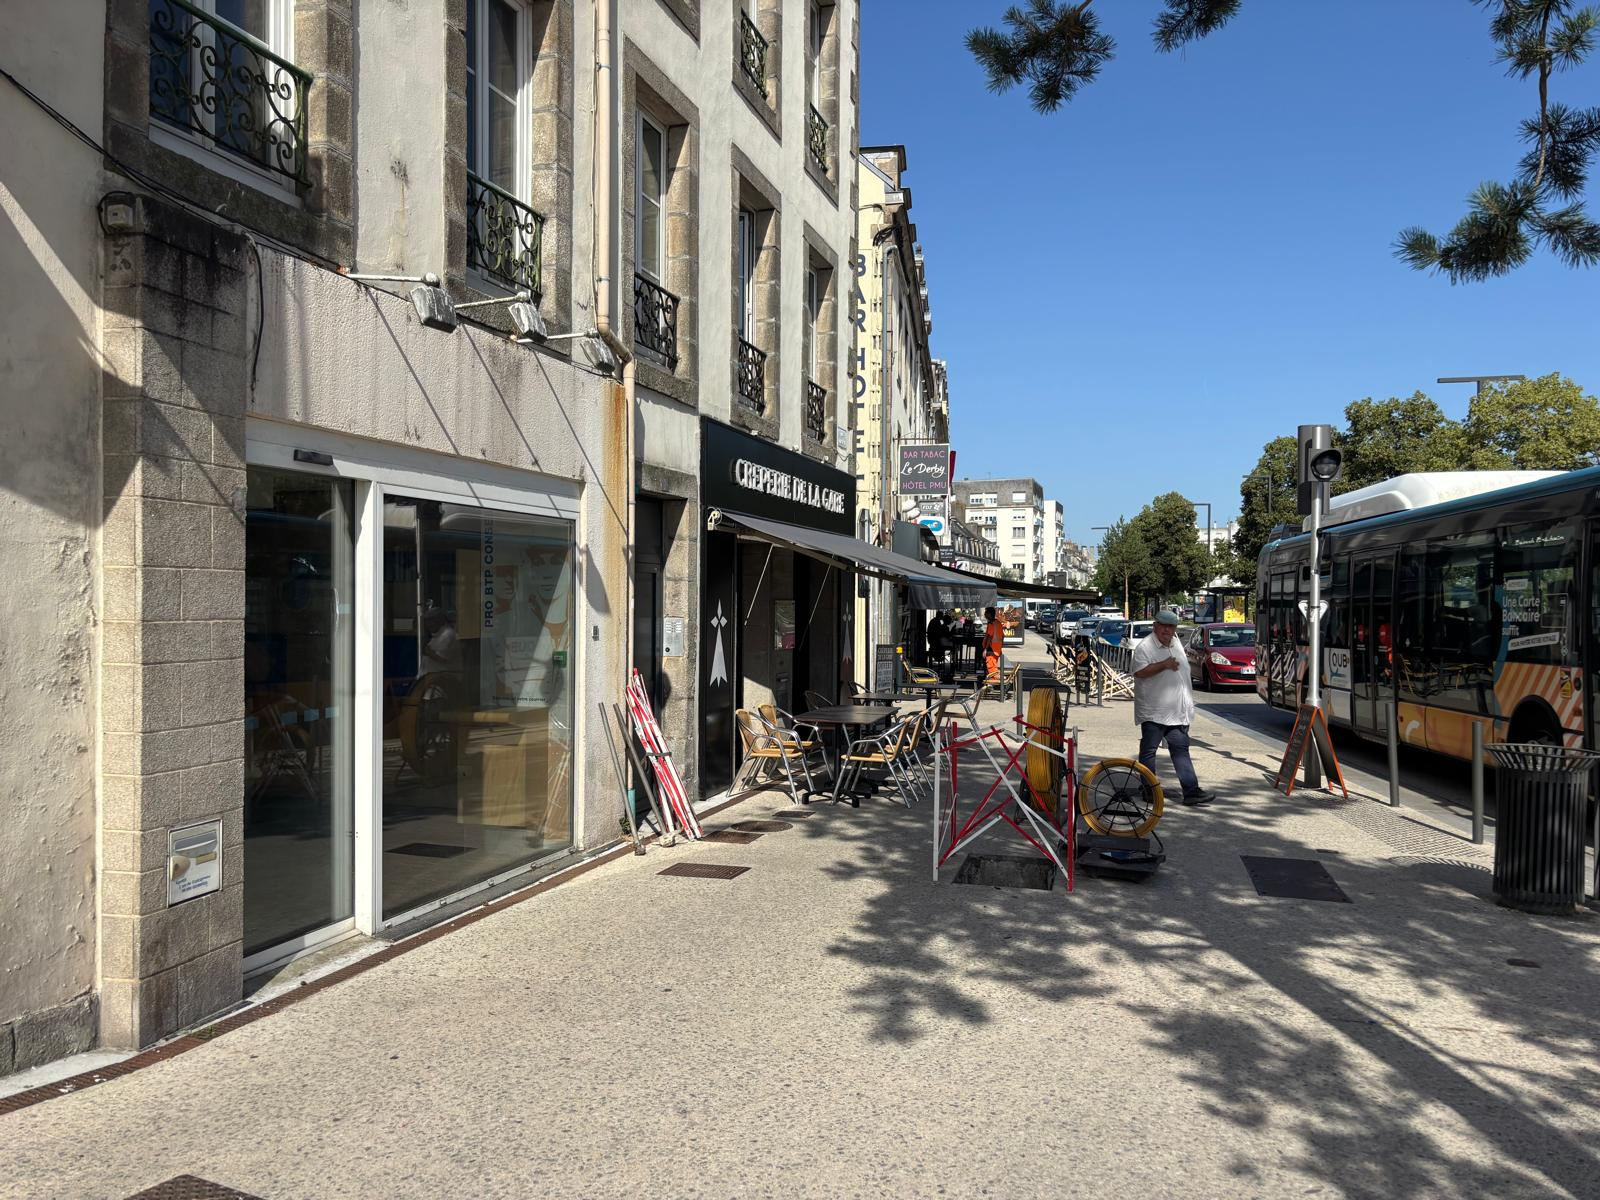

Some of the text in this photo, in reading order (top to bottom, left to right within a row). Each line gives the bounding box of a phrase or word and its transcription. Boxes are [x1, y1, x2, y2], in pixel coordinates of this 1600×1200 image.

[903, 450, 945, 459] BAR TABAC
[900, 461, 946, 479] Le Derby
[902, 481, 947, 490] HÔTEL PMU
[792, 476, 808, 504] DE
[807, 482, 821, 508] LA
[821, 488, 845, 514] GARE
[484, 570, 494, 596] BTP
[1502, 595, 1540, 607] Une Carte
[484, 600, 494, 628] PRO
[1502, 608, 1541, 622] Bancaire
